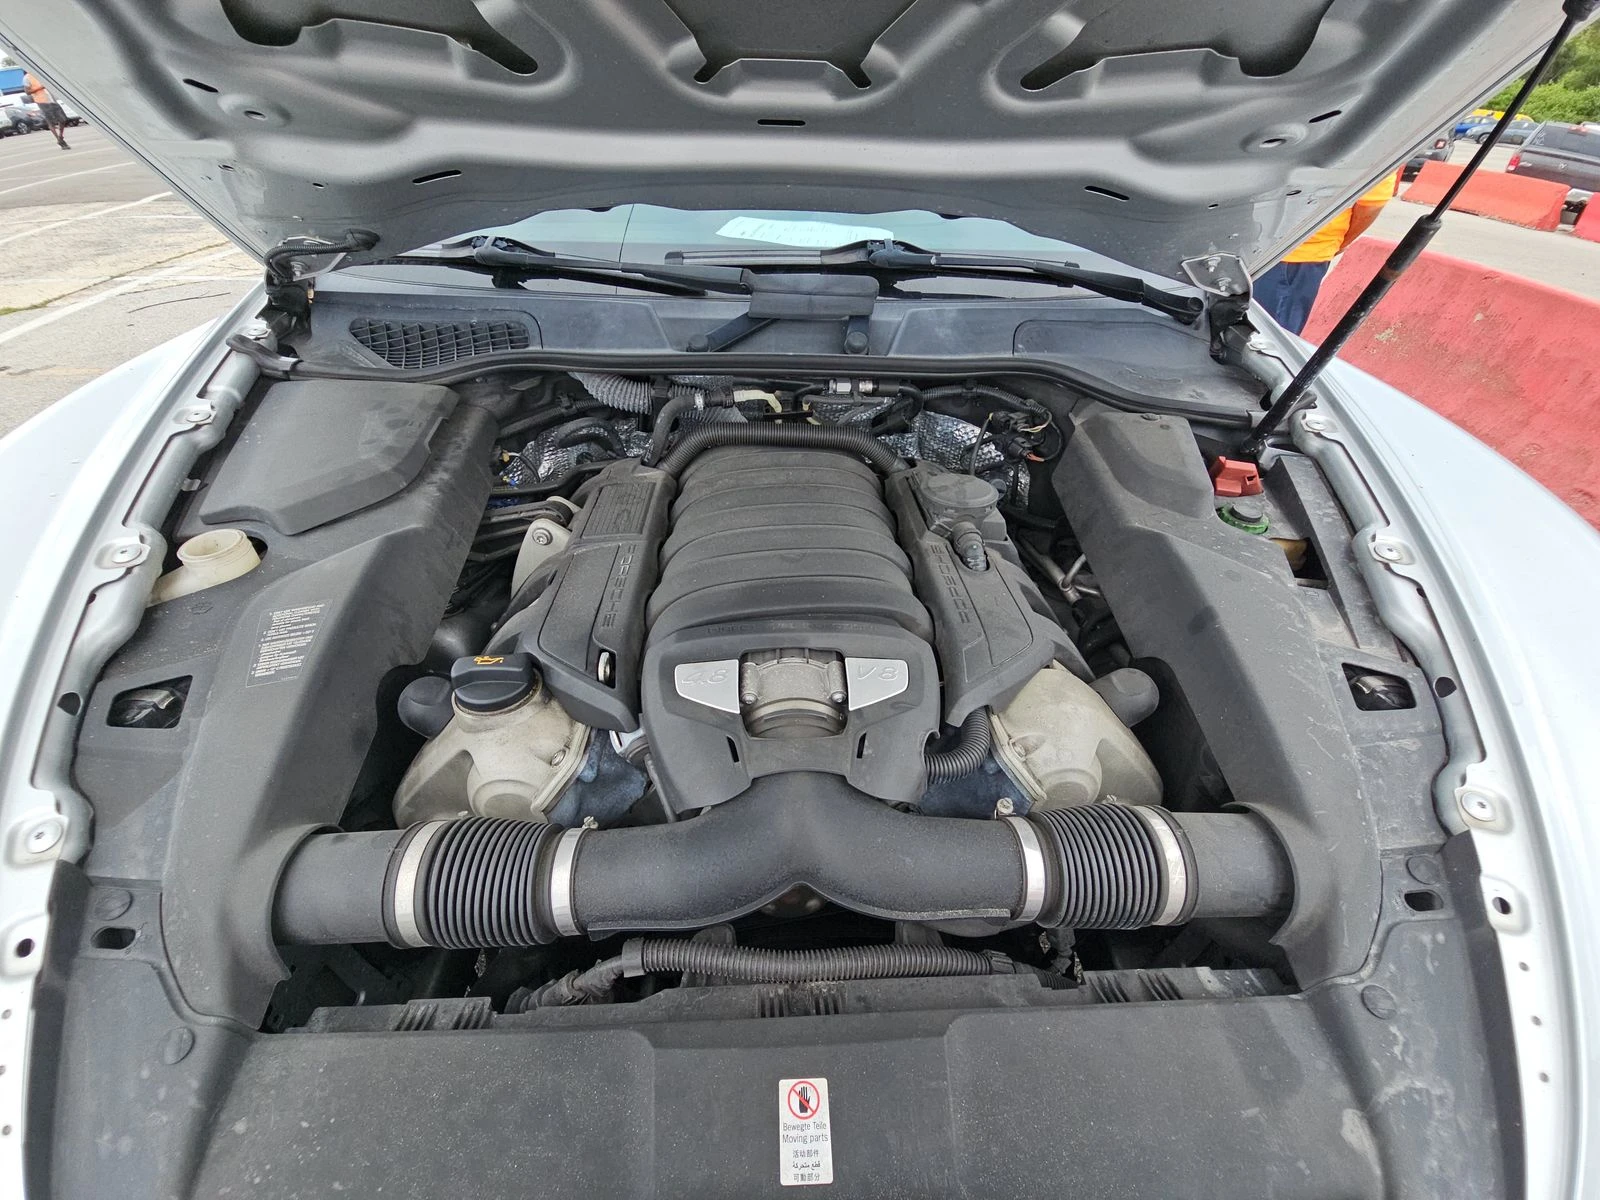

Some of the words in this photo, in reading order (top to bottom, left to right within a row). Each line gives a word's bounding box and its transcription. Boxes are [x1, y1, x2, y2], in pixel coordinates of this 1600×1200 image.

[857, 664, 899, 682] V8
[783, 1122, 811, 1133] Bewegte
[813, 1121, 827, 1130] Teile
[782, 1134, 808, 1145] Moving
[810, 1133, 829, 1144] parts
